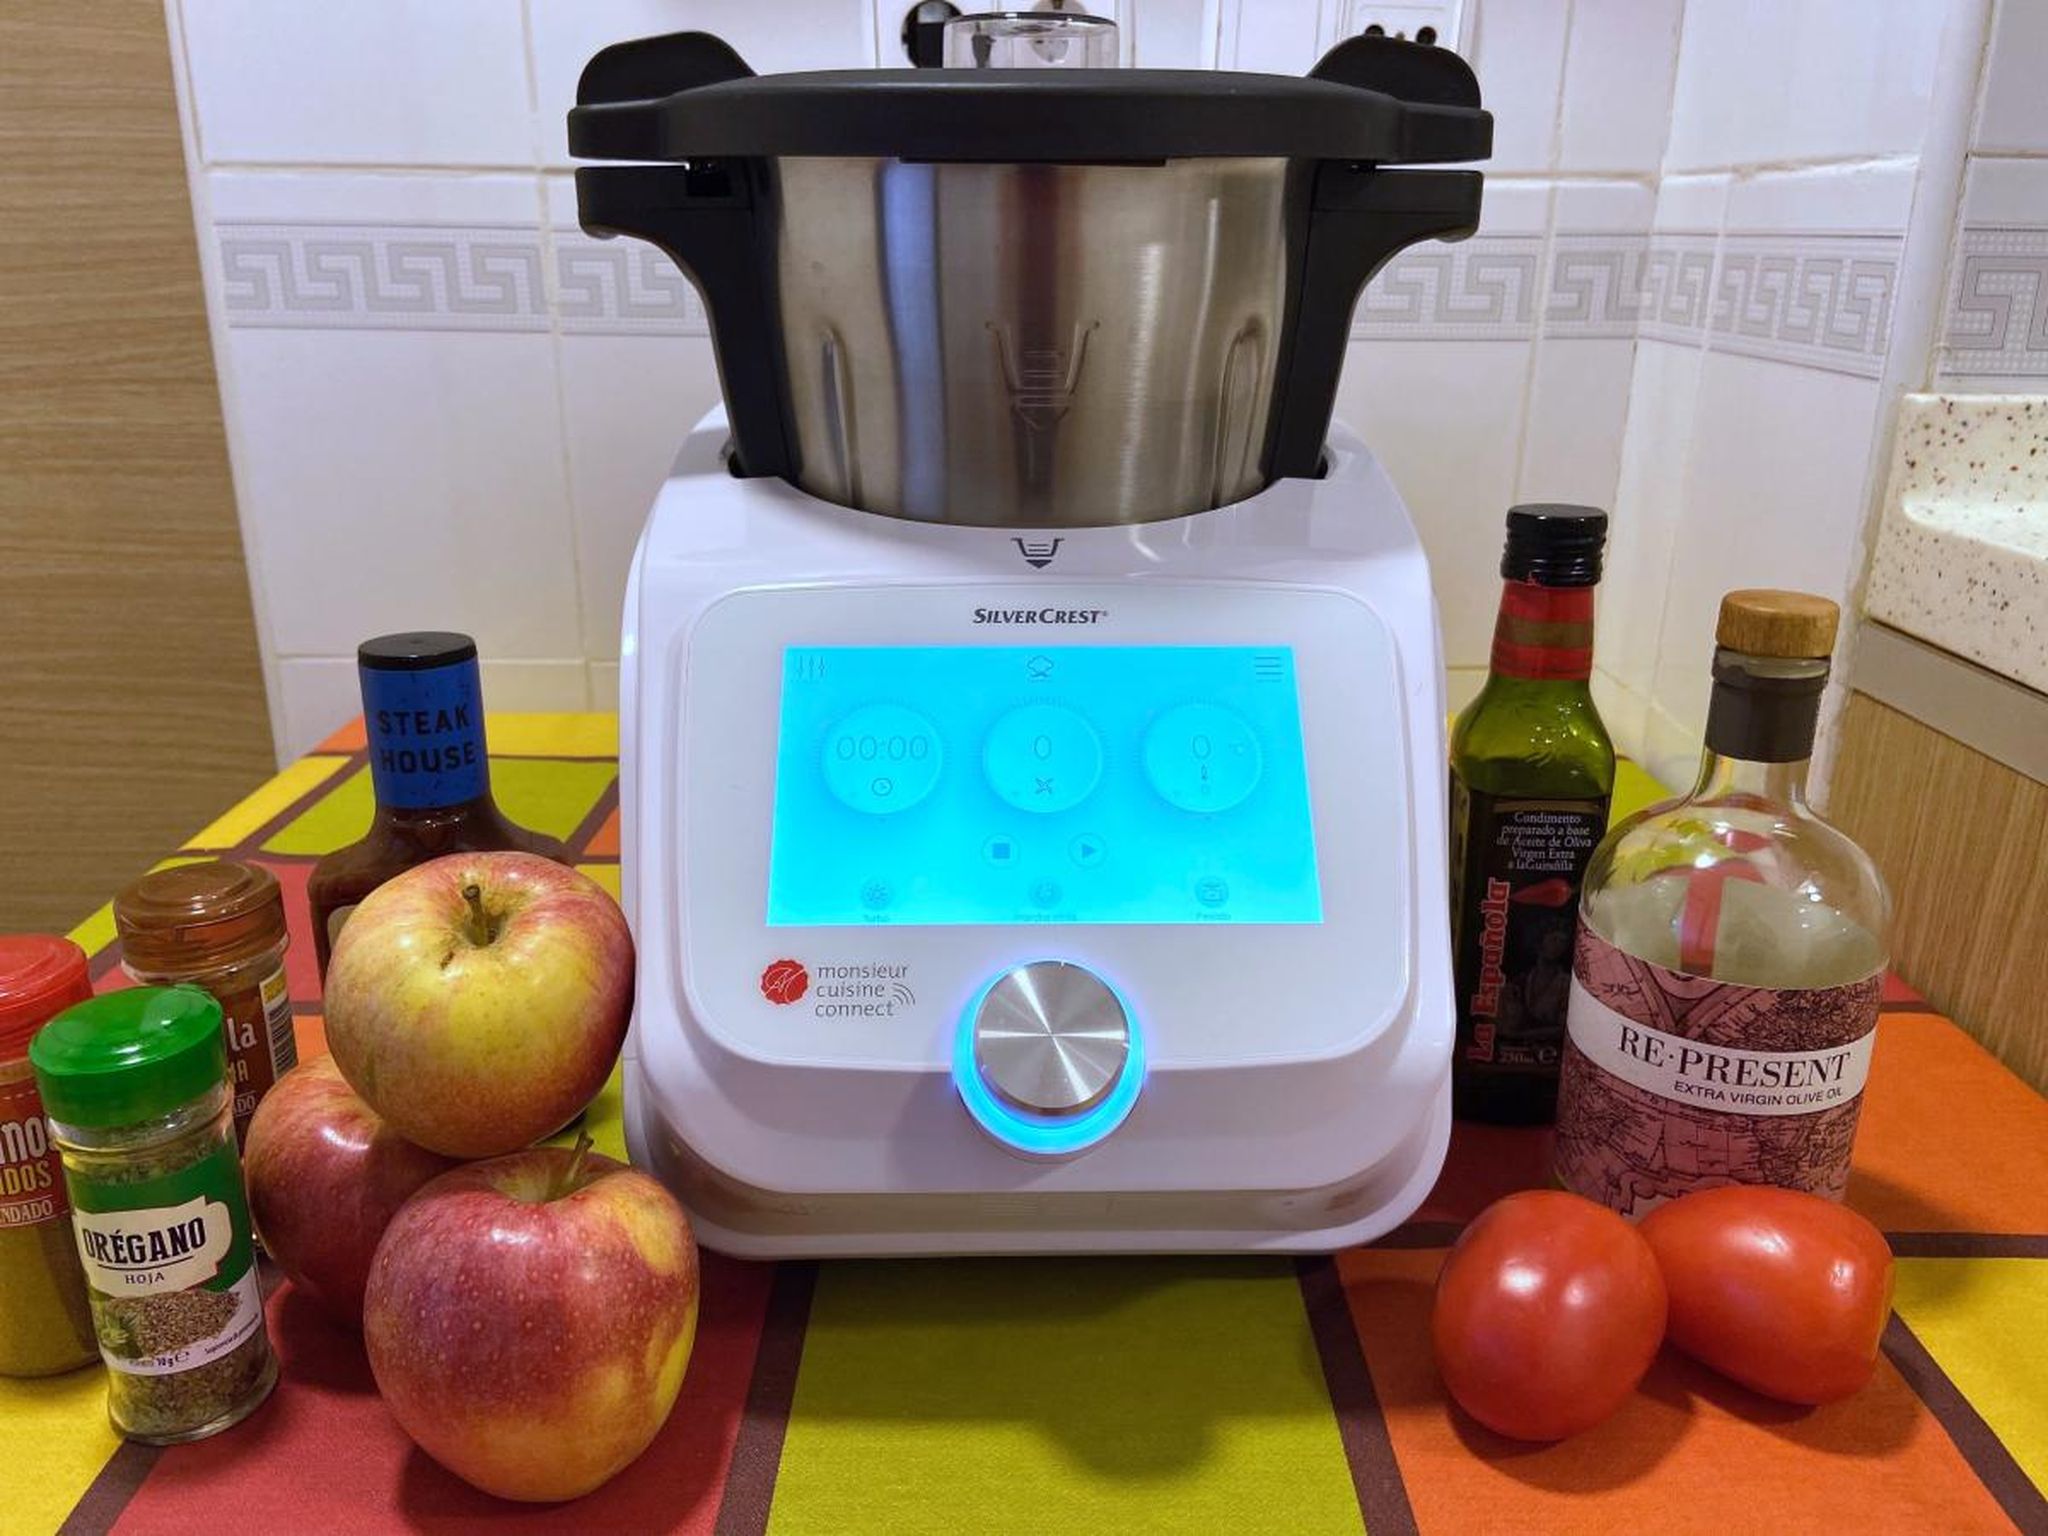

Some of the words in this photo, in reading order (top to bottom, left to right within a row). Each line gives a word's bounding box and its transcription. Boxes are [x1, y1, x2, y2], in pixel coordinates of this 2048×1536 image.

[377, 703, 470, 736] STEAK
[379, 740, 478, 774] HOUSE
[837, 736, 928, 761] 00:00
[1514, 811, 1581, 824] Condimento
[1502, 824, 1556, 840] preparado
[1557, 826, 1564, 836] a
[1566, 824, 1590, 836] base
[1512, 836, 1546, 848] Aceite
[1549, 835, 1561, 847] de
[1564, 835, 1592, 848] Oliva
[1512, 846, 1546, 860] Virgen
[1549, 848, 1575, 859] Extra
[1470, 876, 1511, 1016] Española
[817, 963, 908, 979] monsieur
[816, 981, 885, 998] cuisine
[815, 1002, 895, 1018] connect
[1467, 1023, 1496, 1061] La
[1674, 1080, 1725, 1101] EXTRA
[1730, 1092, 1782, 1106] VIRGIN
[1786, 1091, 1823, 1105] OLIVE
[82, 1216, 206, 1264] ORÉGANO
[125, 1272, 166, 1286] HOJA
